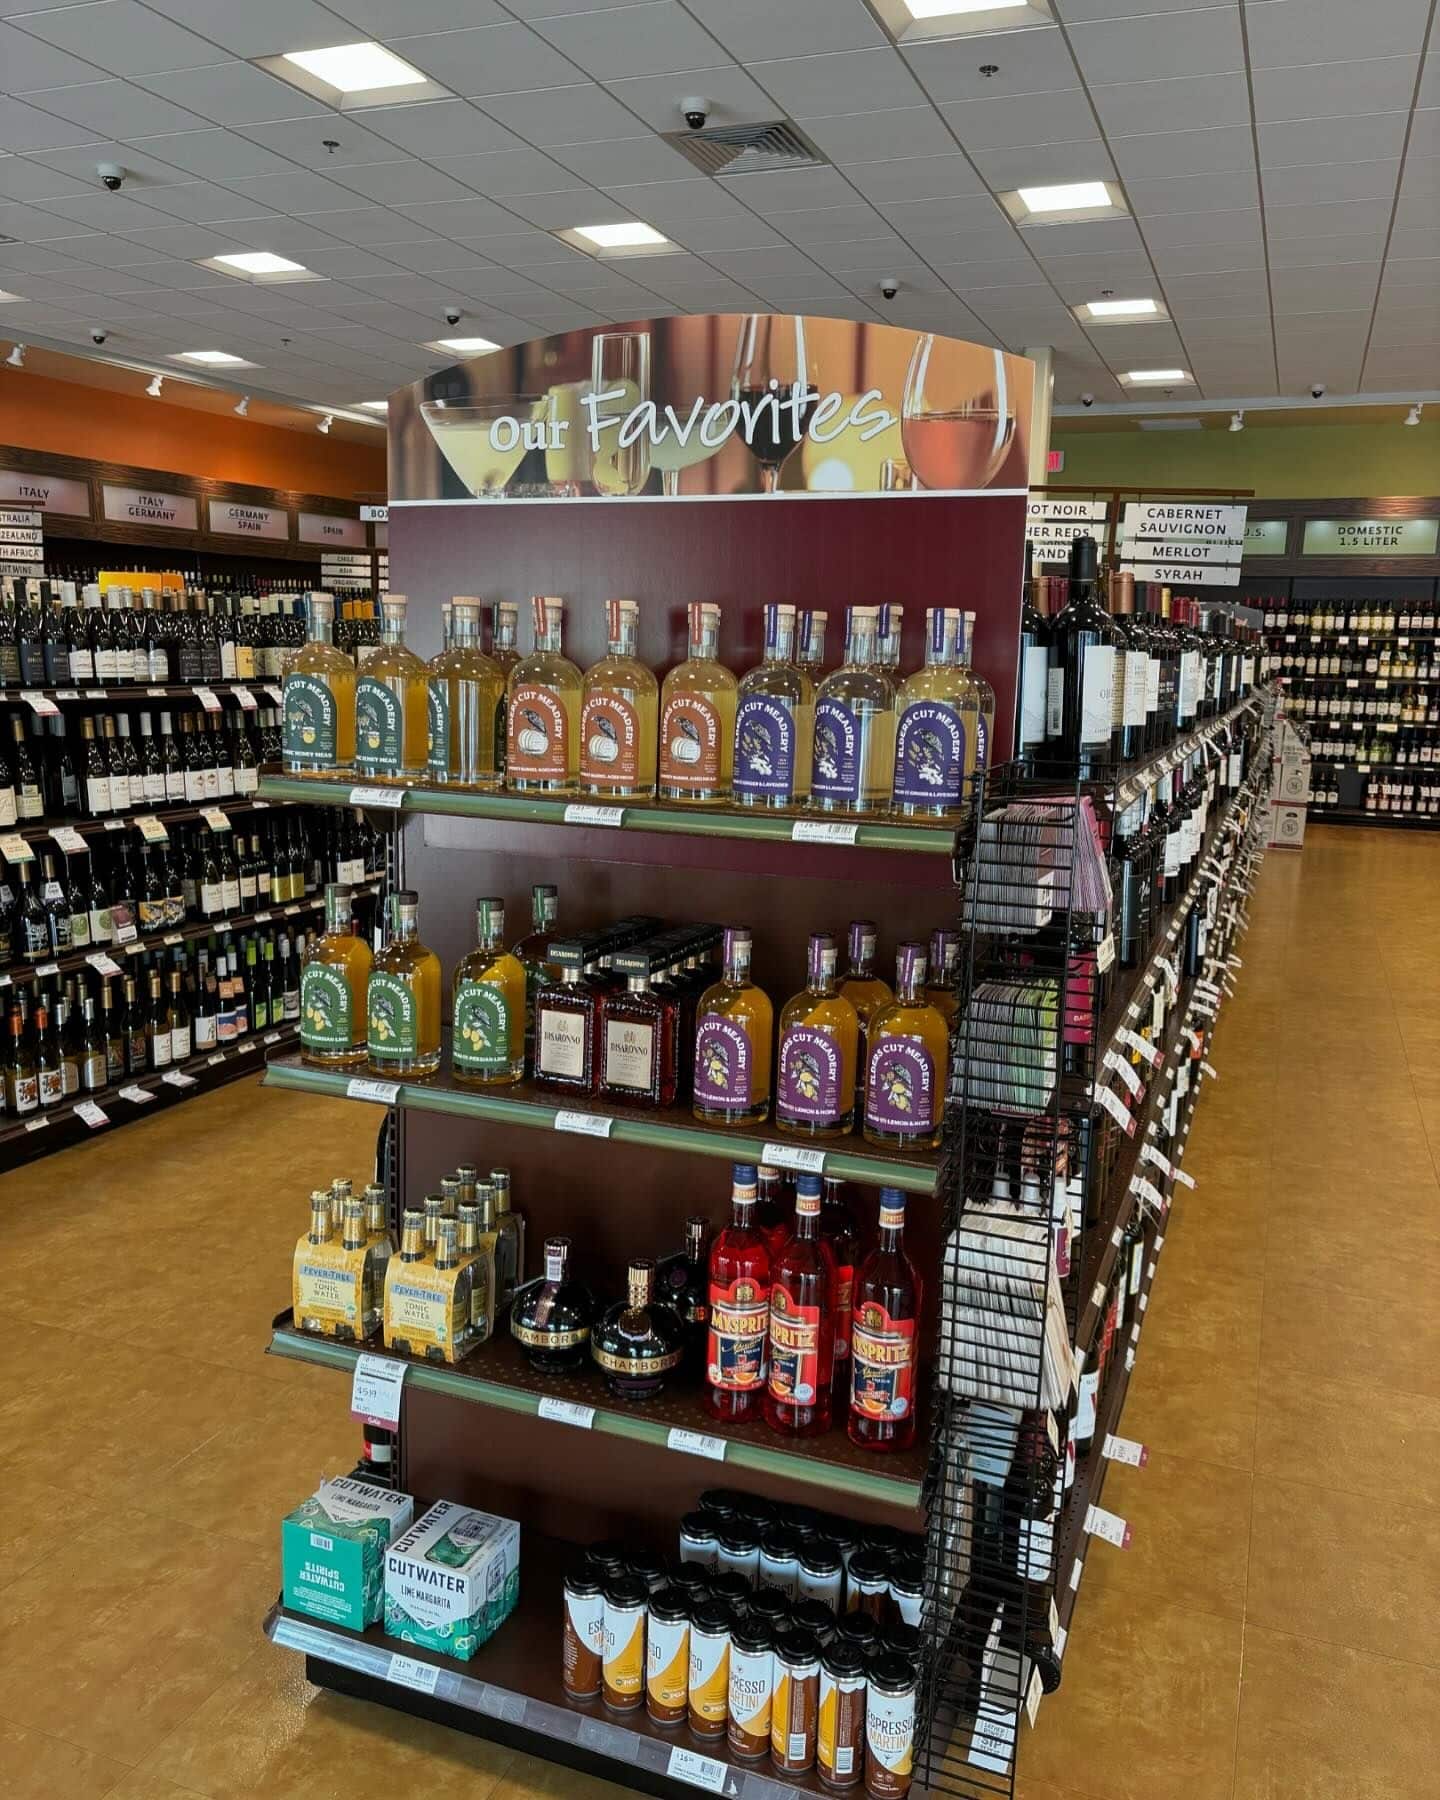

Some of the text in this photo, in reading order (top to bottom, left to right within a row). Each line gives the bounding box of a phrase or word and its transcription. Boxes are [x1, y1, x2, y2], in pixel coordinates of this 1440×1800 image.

[489, 377, 898, 454] our Favorites
[19, 486, 50, 500] ITALY
[138, 495, 165, 507] ITALY
[128, 506, 176, 521] GERMANY
[228, 507, 270, 521] GERMANY
[1052, 505, 1088, 516] NOIR
[1146, 507, 1223, 521] CABERNET
[237, 520, 262, 531] SPAIN
[1139, 522, 1227, 536] SAUVIGNON
[1337, 526, 1404, 536] DOMESTIC
[1, 530, 38, 541] ZEALAND
[1055, 527, 1090, 538] REDS
[1339, 536, 1399, 546] 1.5 LITER
[1152, 545, 1211, 558] MERLOT
[1154, 568, 1203, 581] SYRAH
[289, 680, 307, 690] CUT
[518, 691, 537, 701] CUT
[590, 698, 608, 708] CUT
[672, 699, 692, 709] CUT
[744, 702, 764, 713] CUT
[898, 709, 962, 762] ELDERS CUT MEADERY
[307, 970, 324, 980] CUT
[371, 978, 388, 988] CUT
[464, 988, 484, 997] CUT
[704, 1022, 722, 1032] CUT
[544, 1031, 581, 1045] DISARONNO
[610, 1042, 648, 1056] DISARONNO
[781, 1034, 838, 1083] ELDERS CUT MEADERY
[870, 1044, 930, 1092] ELDERS CUT MEADERY
[303, 1264, 351, 1282] FEVER-TREE
[313, 1282, 338, 1293] TONIC
[394, 1284, 443, 1302] FEVER-TREE
[312, 1290, 340, 1300] WATER
[404, 1302, 430, 1313] TONIC
[403, 1310, 430, 1320] WATER
[601, 1354, 678, 1370] CHAMBORD
[330, 1478, 407, 1505] CUTWATER
[347, 1498, 382, 1512] MARGARITA
[392, 1502, 454, 1553] CUTWATER
[304, 1561, 340, 1580] SPIRITS
[388, 1557, 465, 1594] CUTWATER
[299, 1570, 345, 1592] CUTWATER
[401, 1584, 452, 1610] LIME MARGARITA
